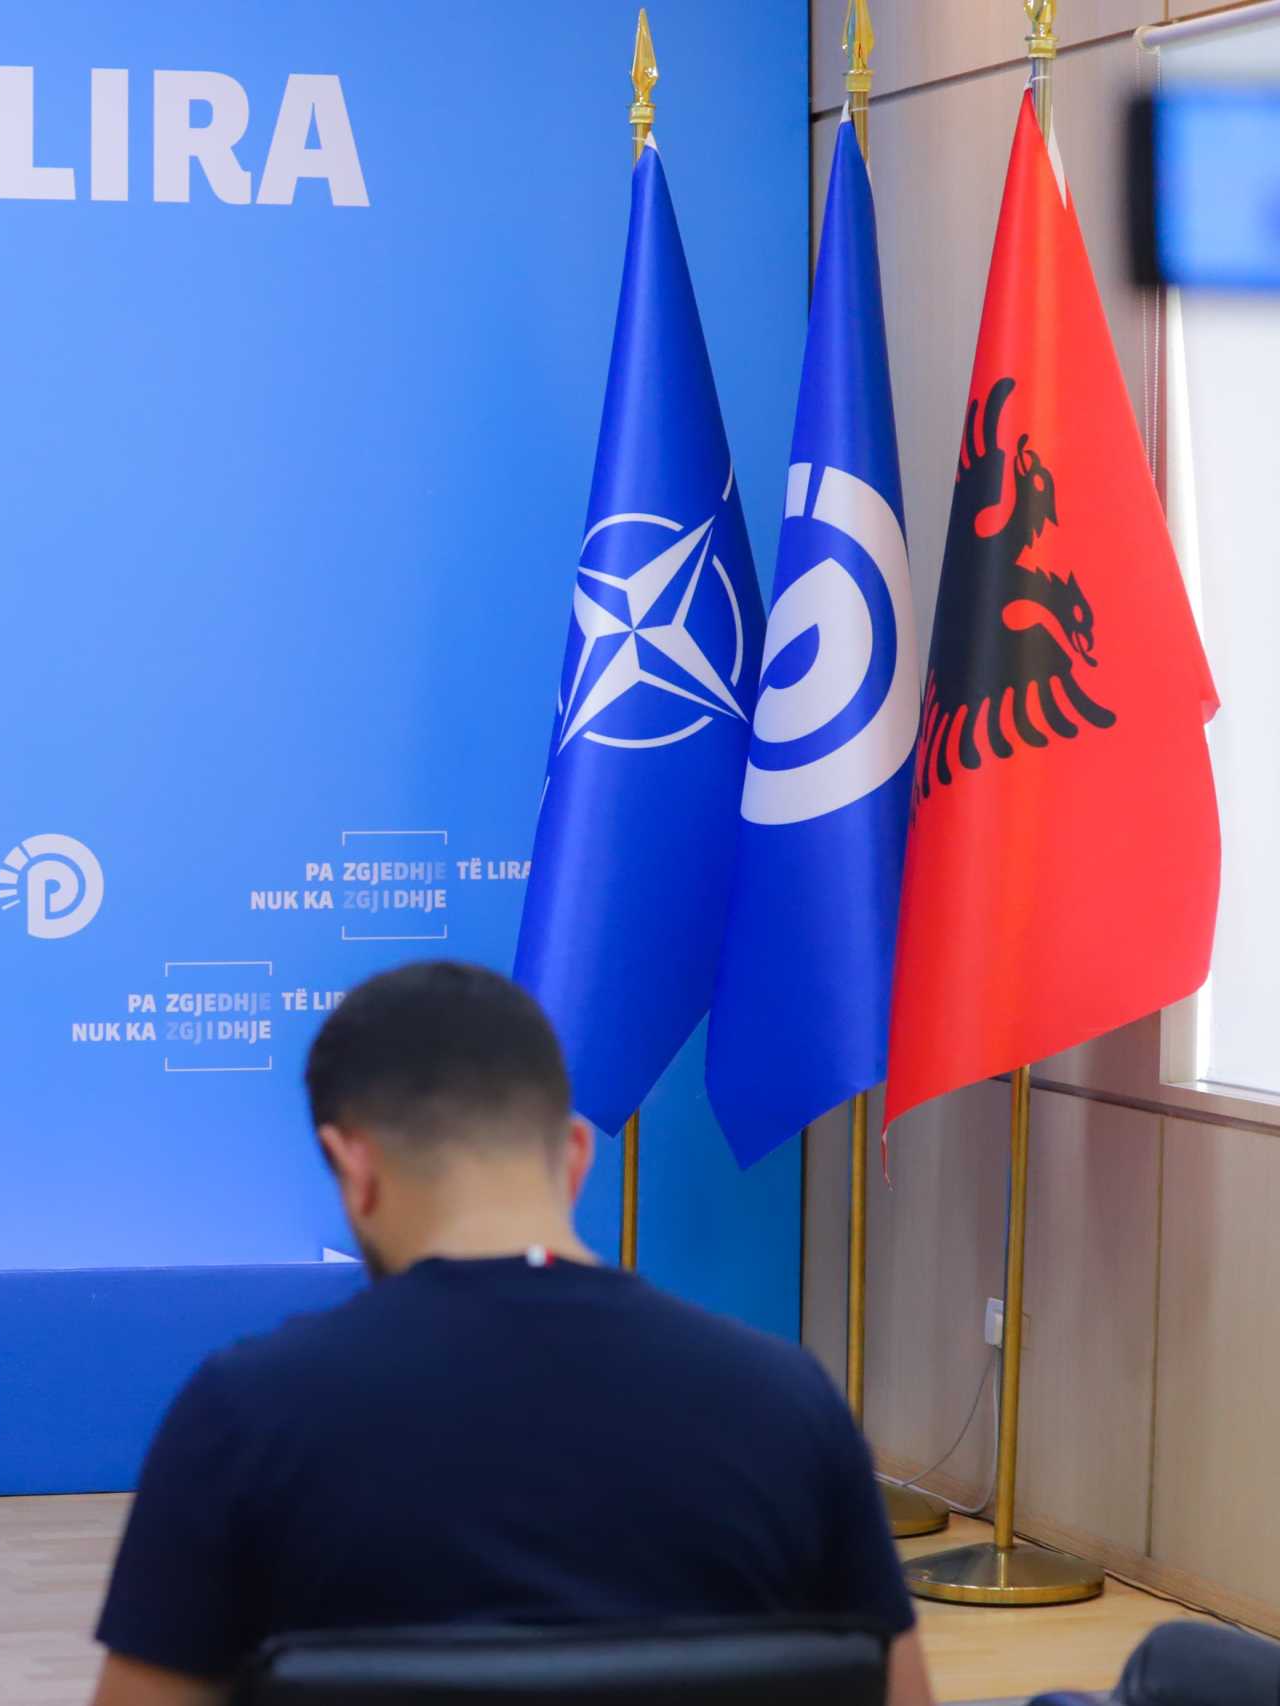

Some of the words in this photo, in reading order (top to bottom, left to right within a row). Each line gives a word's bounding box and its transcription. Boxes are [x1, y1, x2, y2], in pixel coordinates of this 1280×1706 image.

[305, 862, 334, 882] PA
[342, 861, 446, 886] ZGJEDHJE
[456, 857, 482, 880] TË
[249, 890, 299, 911] NUK
[303, 890, 334, 910] KA
[127, 993, 157, 1014] PA
[165, 992, 271, 1015] ZGJEDHJE
[281, 988, 308, 1011] TË
[312, 991, 346, 1010] LIR
[72, 1022, 121, 1042] NUK
[125, 1021, 157, 1041] KA
